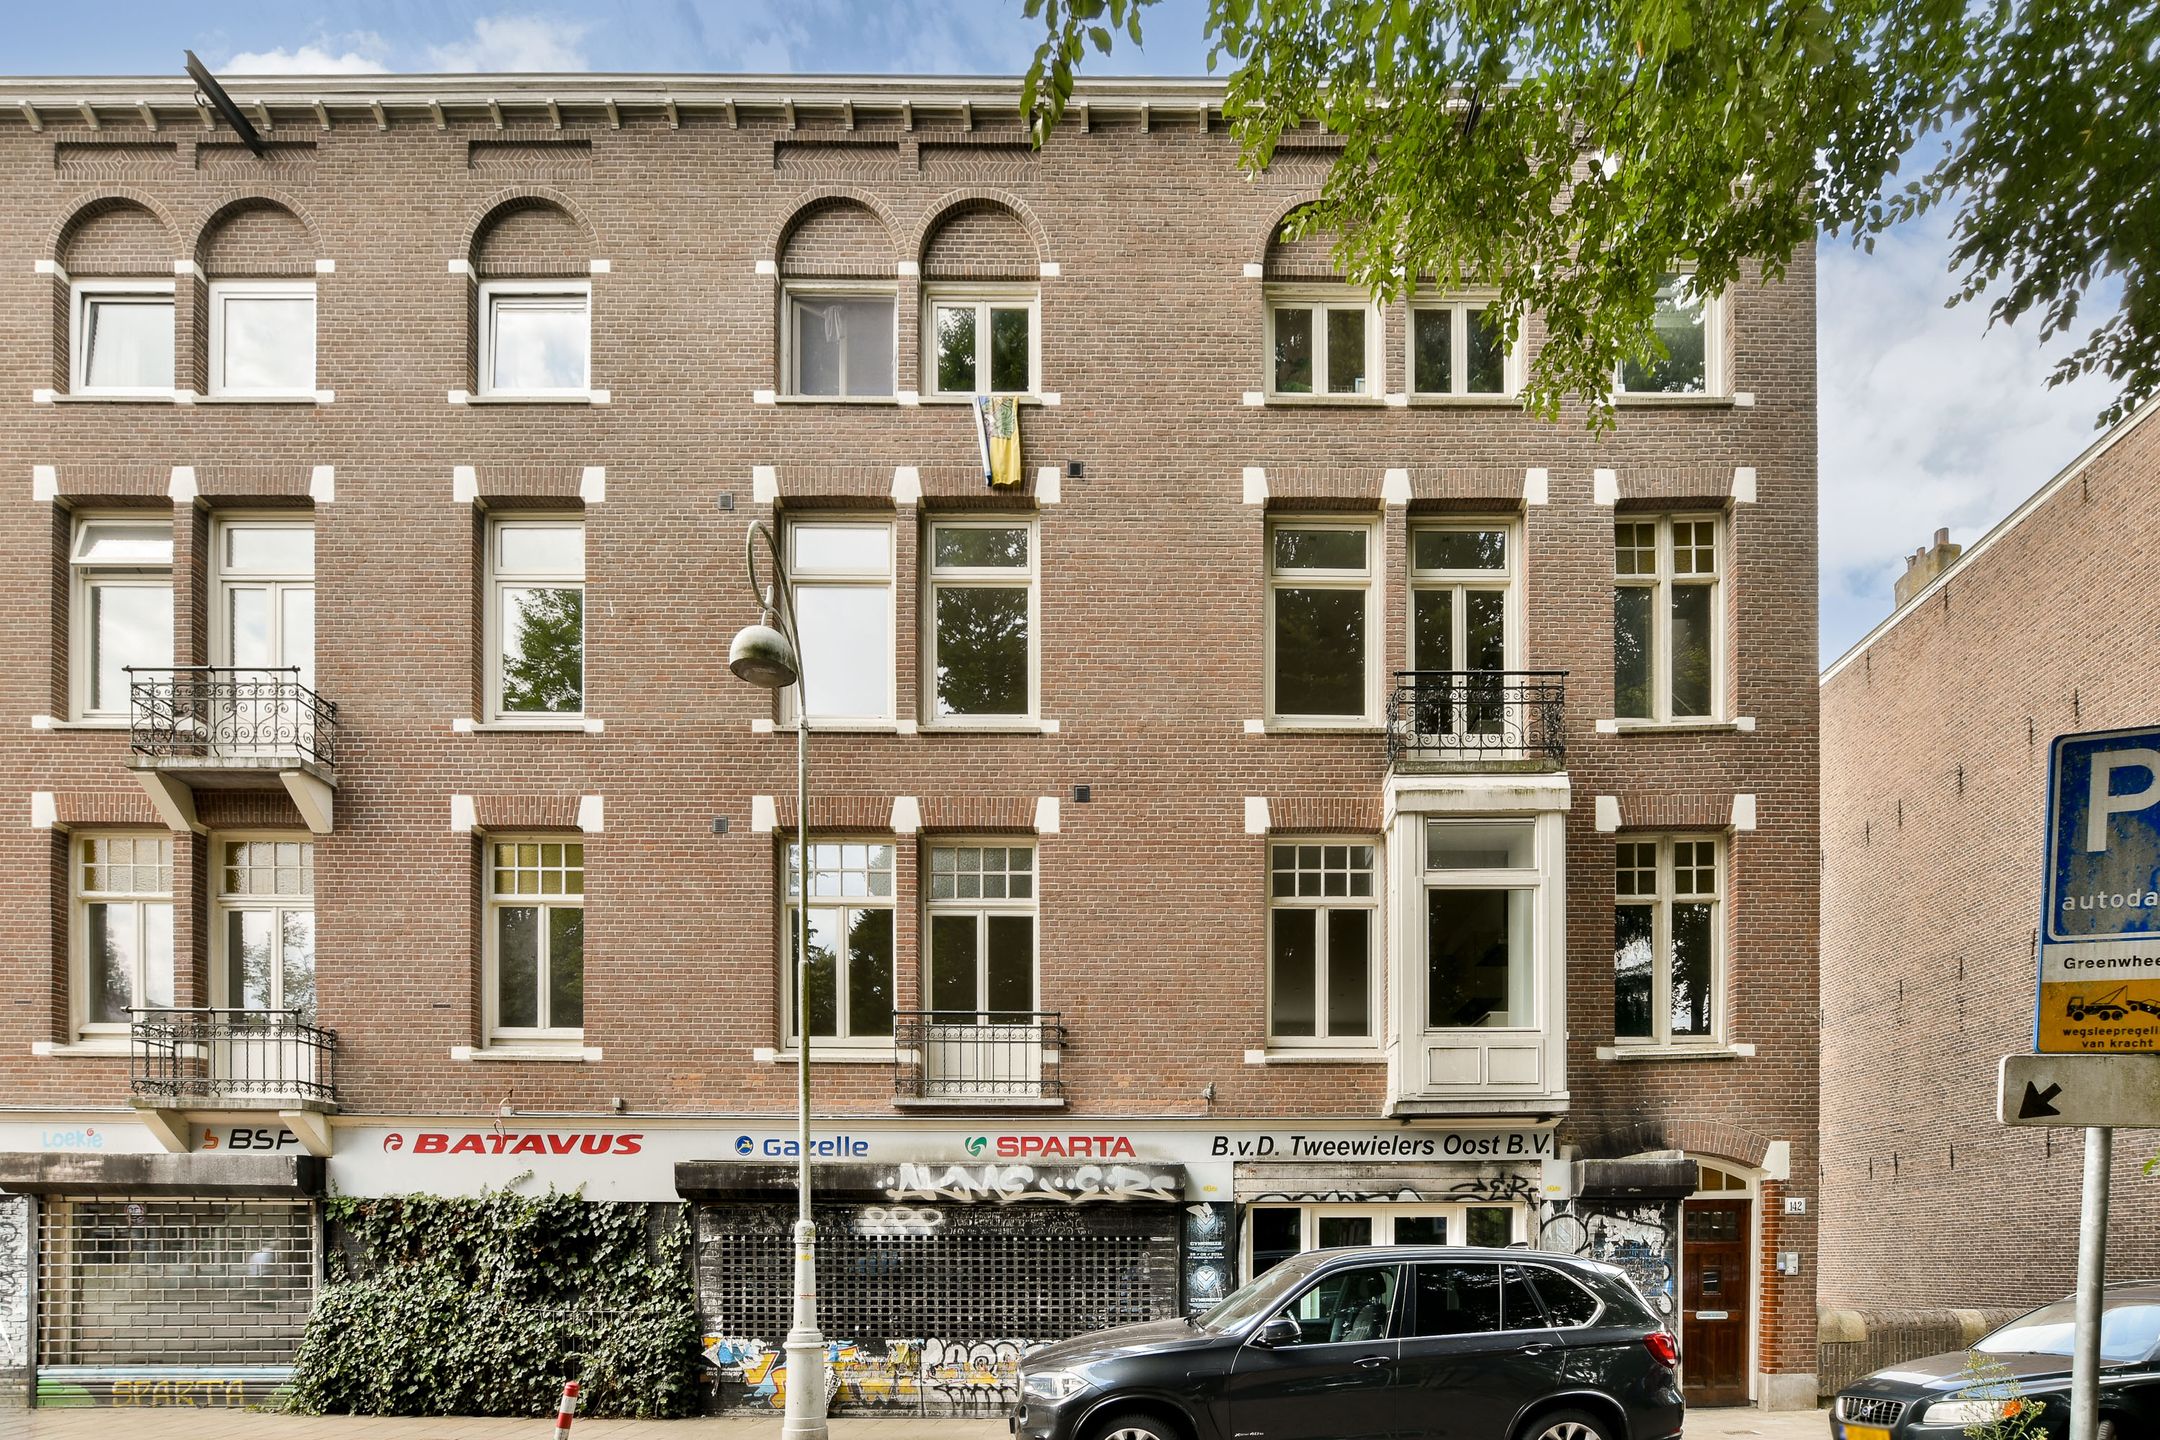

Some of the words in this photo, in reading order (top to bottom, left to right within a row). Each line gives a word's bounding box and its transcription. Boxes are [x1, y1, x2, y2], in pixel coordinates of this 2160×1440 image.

[2086, 749, 2160, 852] P
[2062, 889, 2158, 911] autoda
[2082, 1040, 2104, 1048] van
[2110, 1039, 2154, 1048] kracht
[42, 1128, 104, 1149] Loekie
[413, 1133, 644, 1155] BATAVUS
[997, 1136, 1137, 1158] SPARTA
[1212, 1136, 1279, 1156] B.v.D.
[1291, 1135, 1435, 1156] Tweewielers
[1444, 1134, 1500, 1155] Oost
[1507, 1133, 1550, 1155] B.V.
[1789, 1201, 1803, 1211] 142
